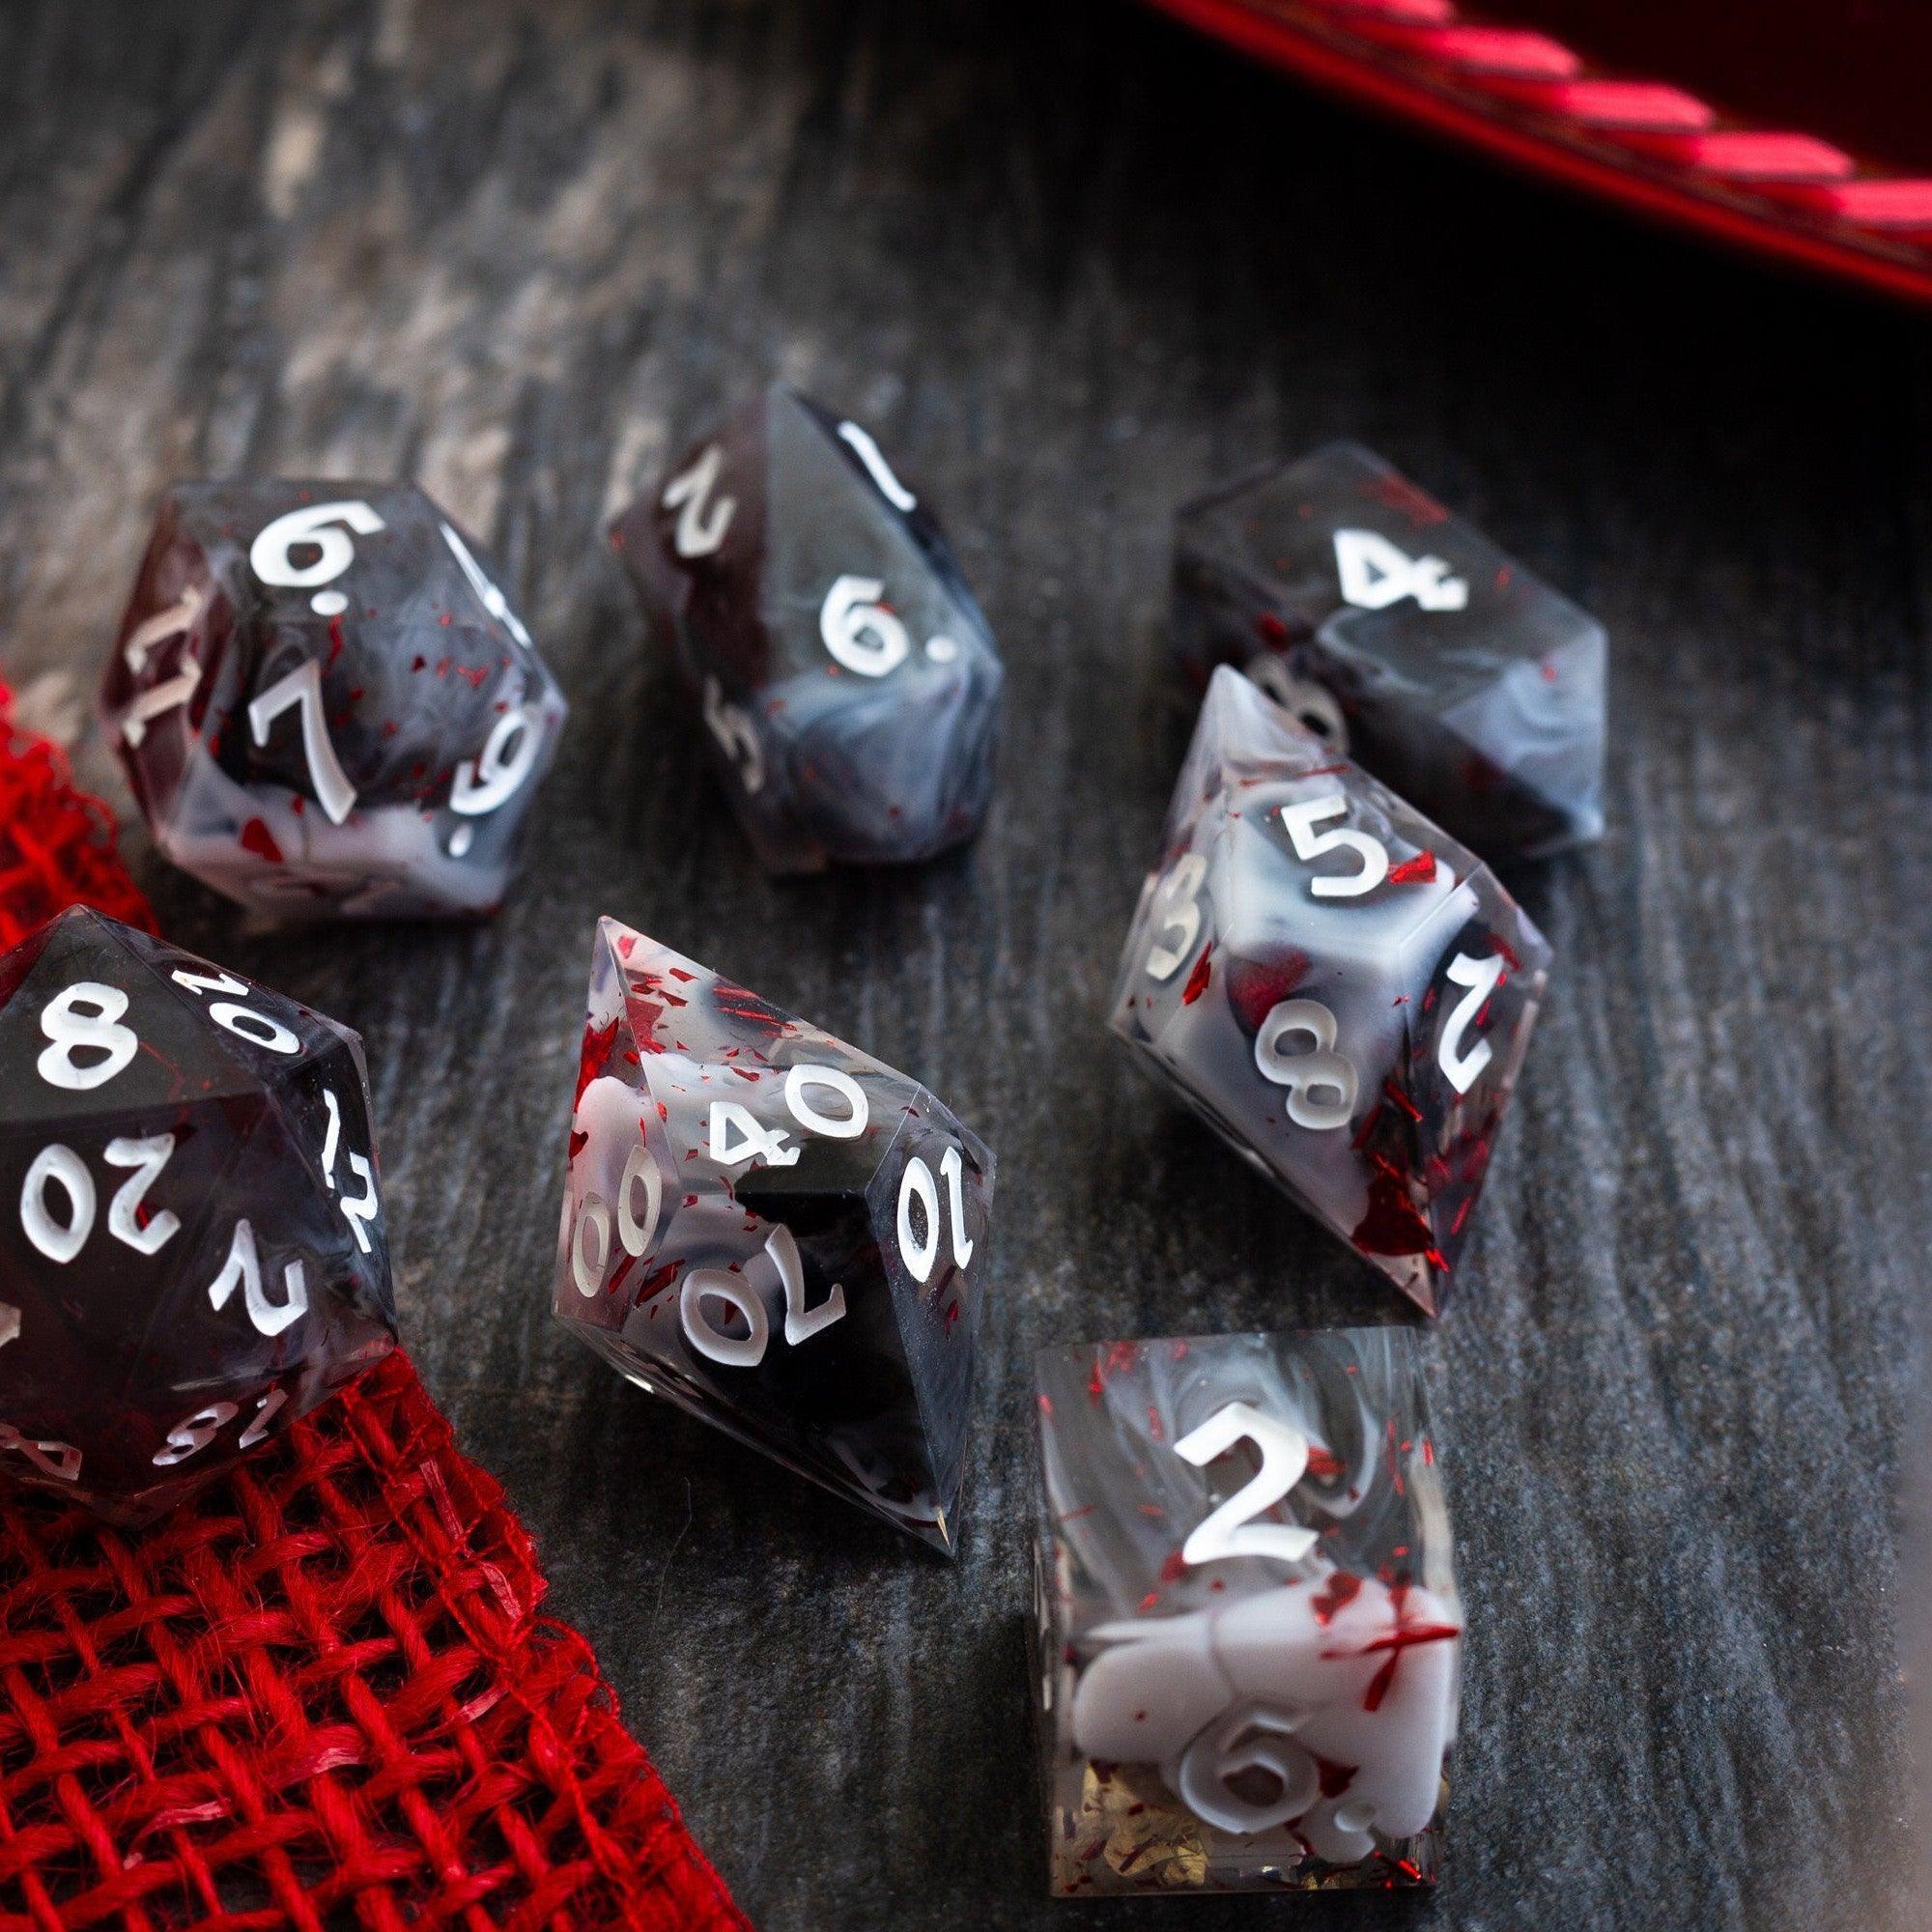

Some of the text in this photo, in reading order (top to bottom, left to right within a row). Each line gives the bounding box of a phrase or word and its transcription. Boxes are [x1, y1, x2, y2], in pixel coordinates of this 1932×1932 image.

[1332, 527, 1470, 611] 4
[248, 658, 359, 827] 7
[1280, 793, 1388, 898] 5
[37, 980, 139, 1092] 8
[171, 967, 302, 1056] 10
[1253, 998, 1360, 1132] 8
[708, 1063, 870, 1168] 40
[19, 1131, 183, 1265] 20
[572, 1143, 663, 1298] 00
[895, 1146, 976, 1285] 10
[208, 1217, 310, 1337] 2
[679, 1223, 848, 1368] 70
[1173, 1400, 1320, 1565] 2
